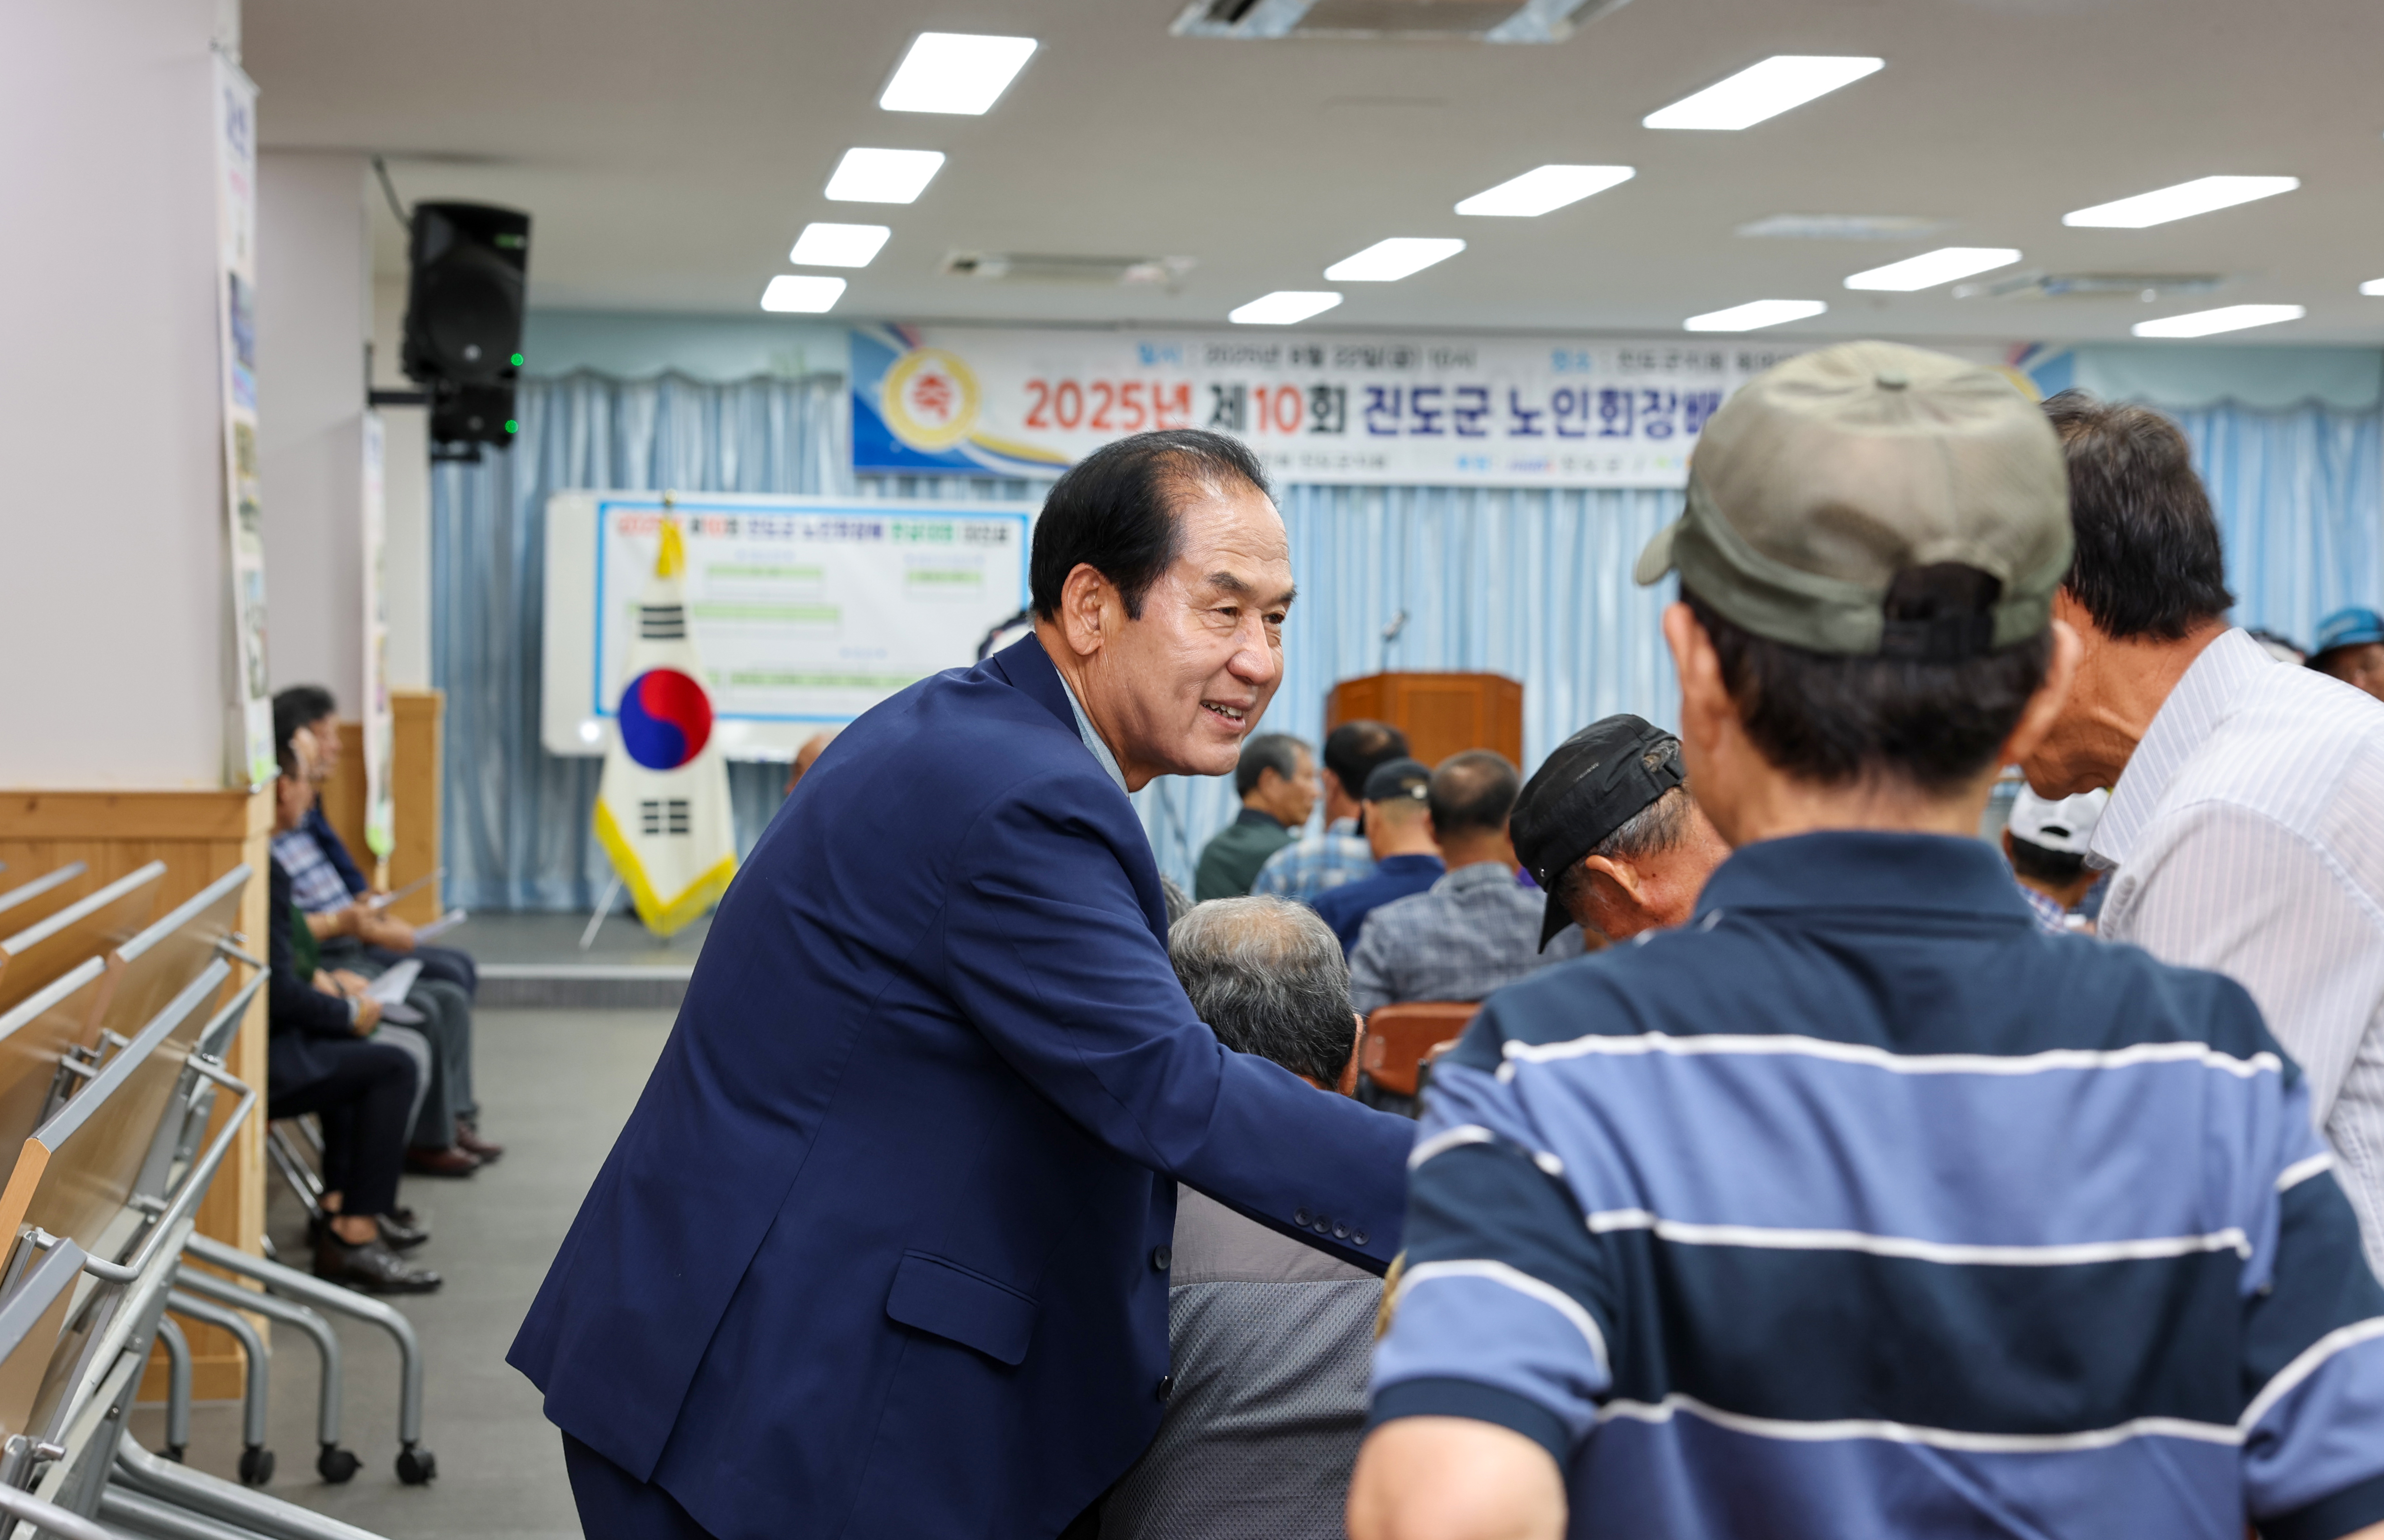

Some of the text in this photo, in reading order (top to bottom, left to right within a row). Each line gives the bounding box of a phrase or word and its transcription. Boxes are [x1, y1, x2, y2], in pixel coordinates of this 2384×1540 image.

[1024, 379, 1725, 439] 2025년 제10회 진도군 노인회장배
